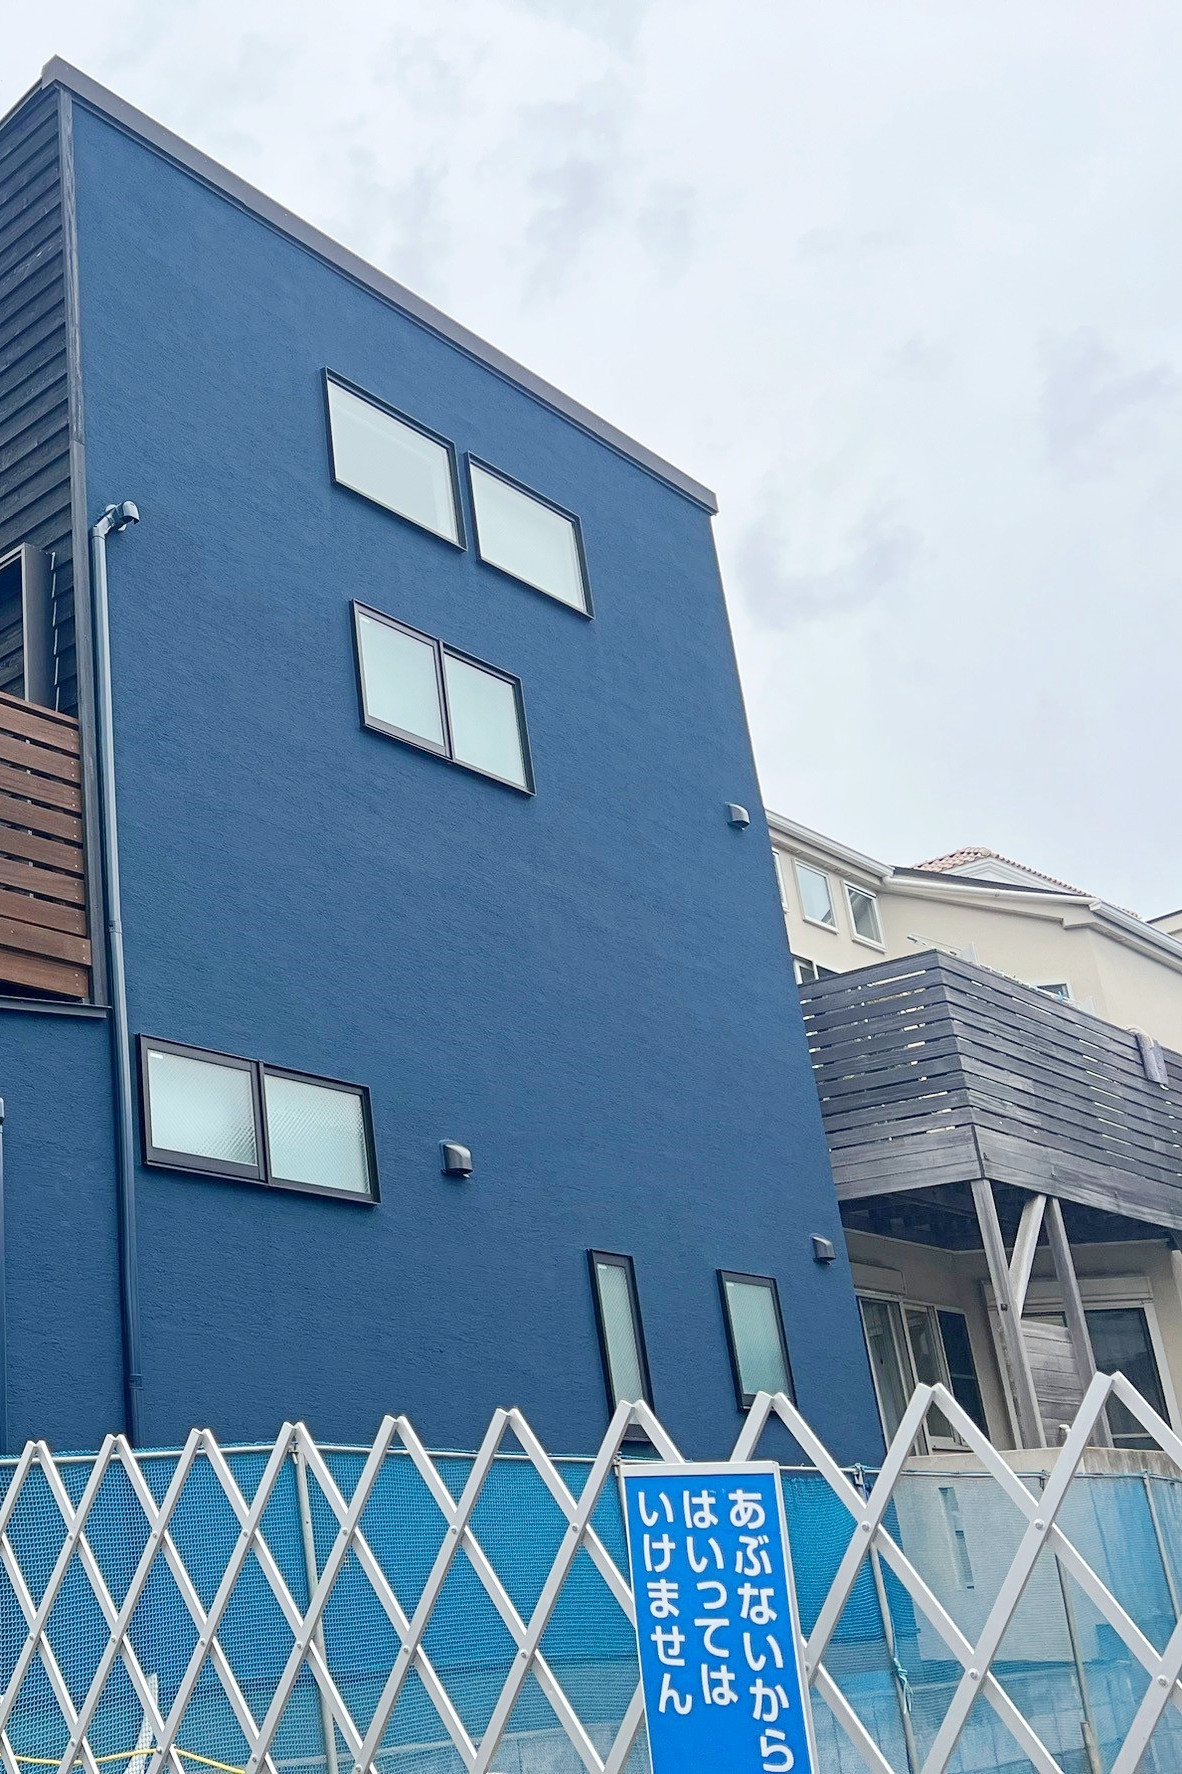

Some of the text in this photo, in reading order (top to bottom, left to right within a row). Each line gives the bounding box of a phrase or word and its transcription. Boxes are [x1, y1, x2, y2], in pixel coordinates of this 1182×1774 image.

[637, 1491, 693, 1716] いけません
[728, 1489, 795, 1773] あぶないから
